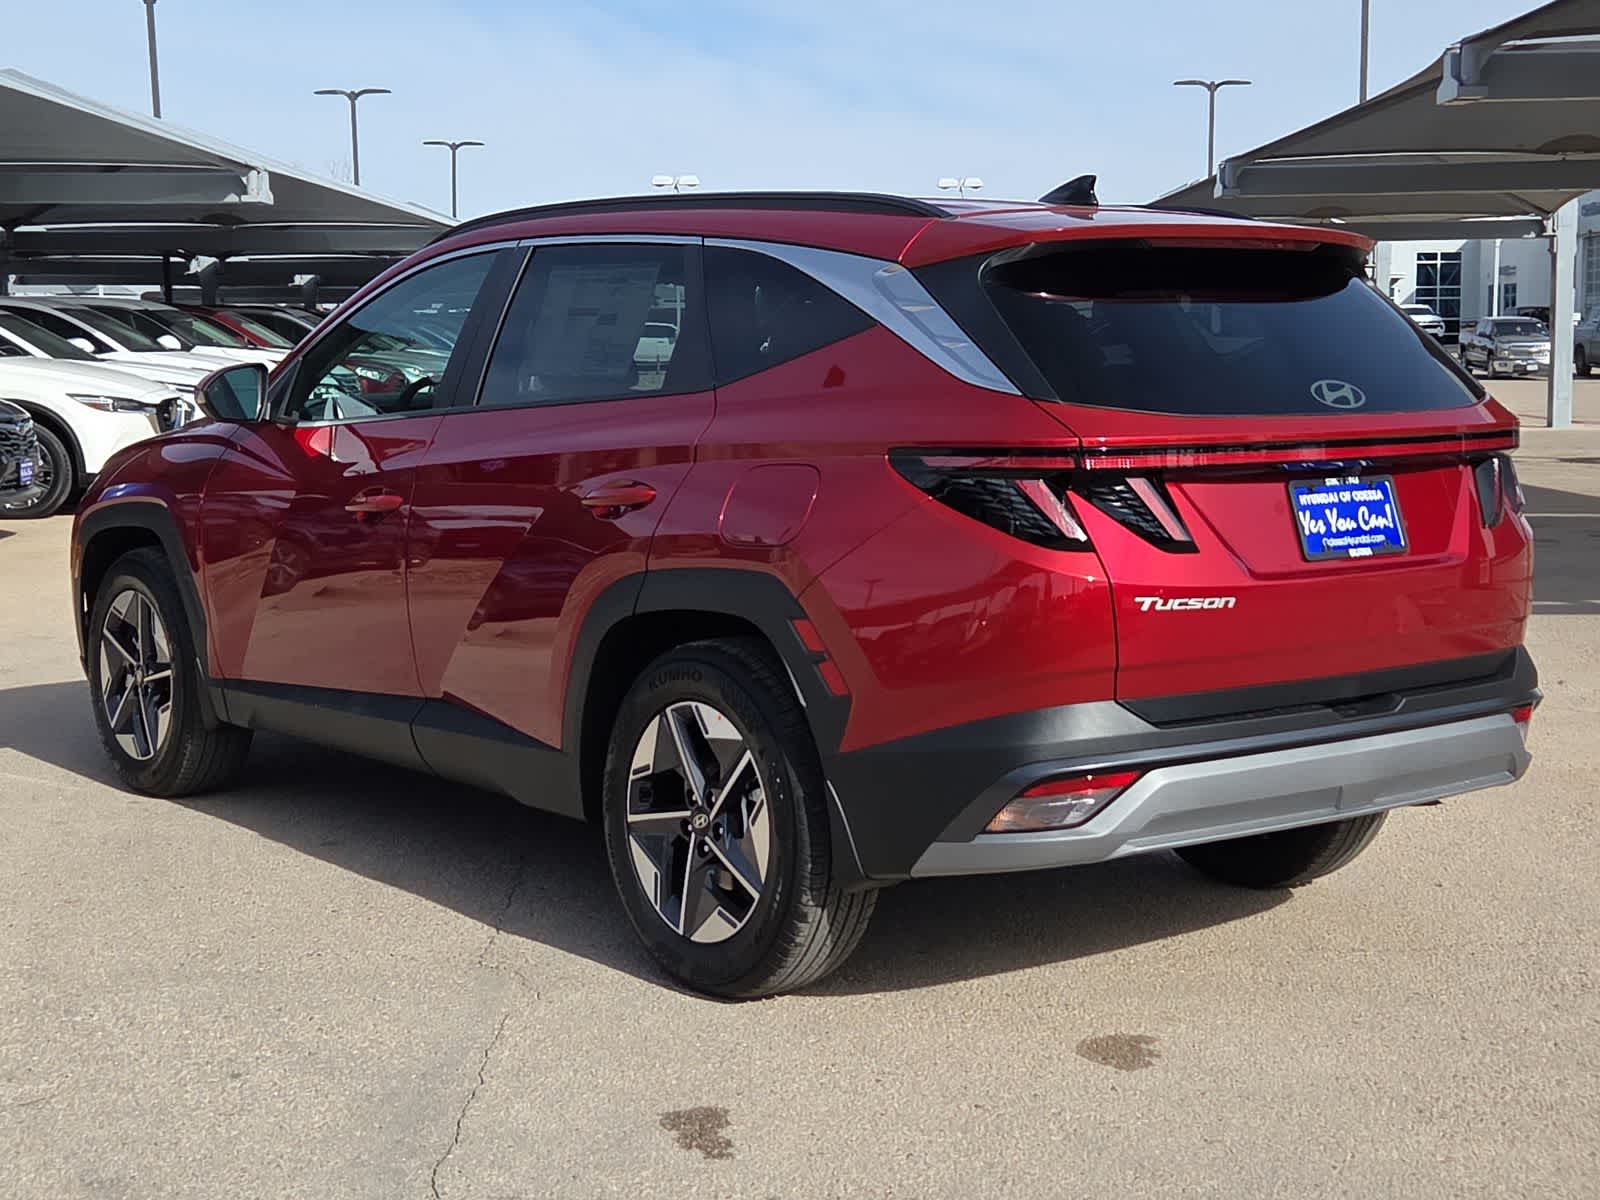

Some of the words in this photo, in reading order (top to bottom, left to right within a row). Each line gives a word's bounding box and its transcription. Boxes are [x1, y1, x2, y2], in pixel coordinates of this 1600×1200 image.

[1339, 490, 1351, 503] OF
[1298, 509, 1326, 536] Yes
[1325, 507, 1357, 533] You
[1358, 503, 1394, 531] Can!
[1134, 596, 1237, 611] Tucson
[648, 668, 703, 690] KUMHO
